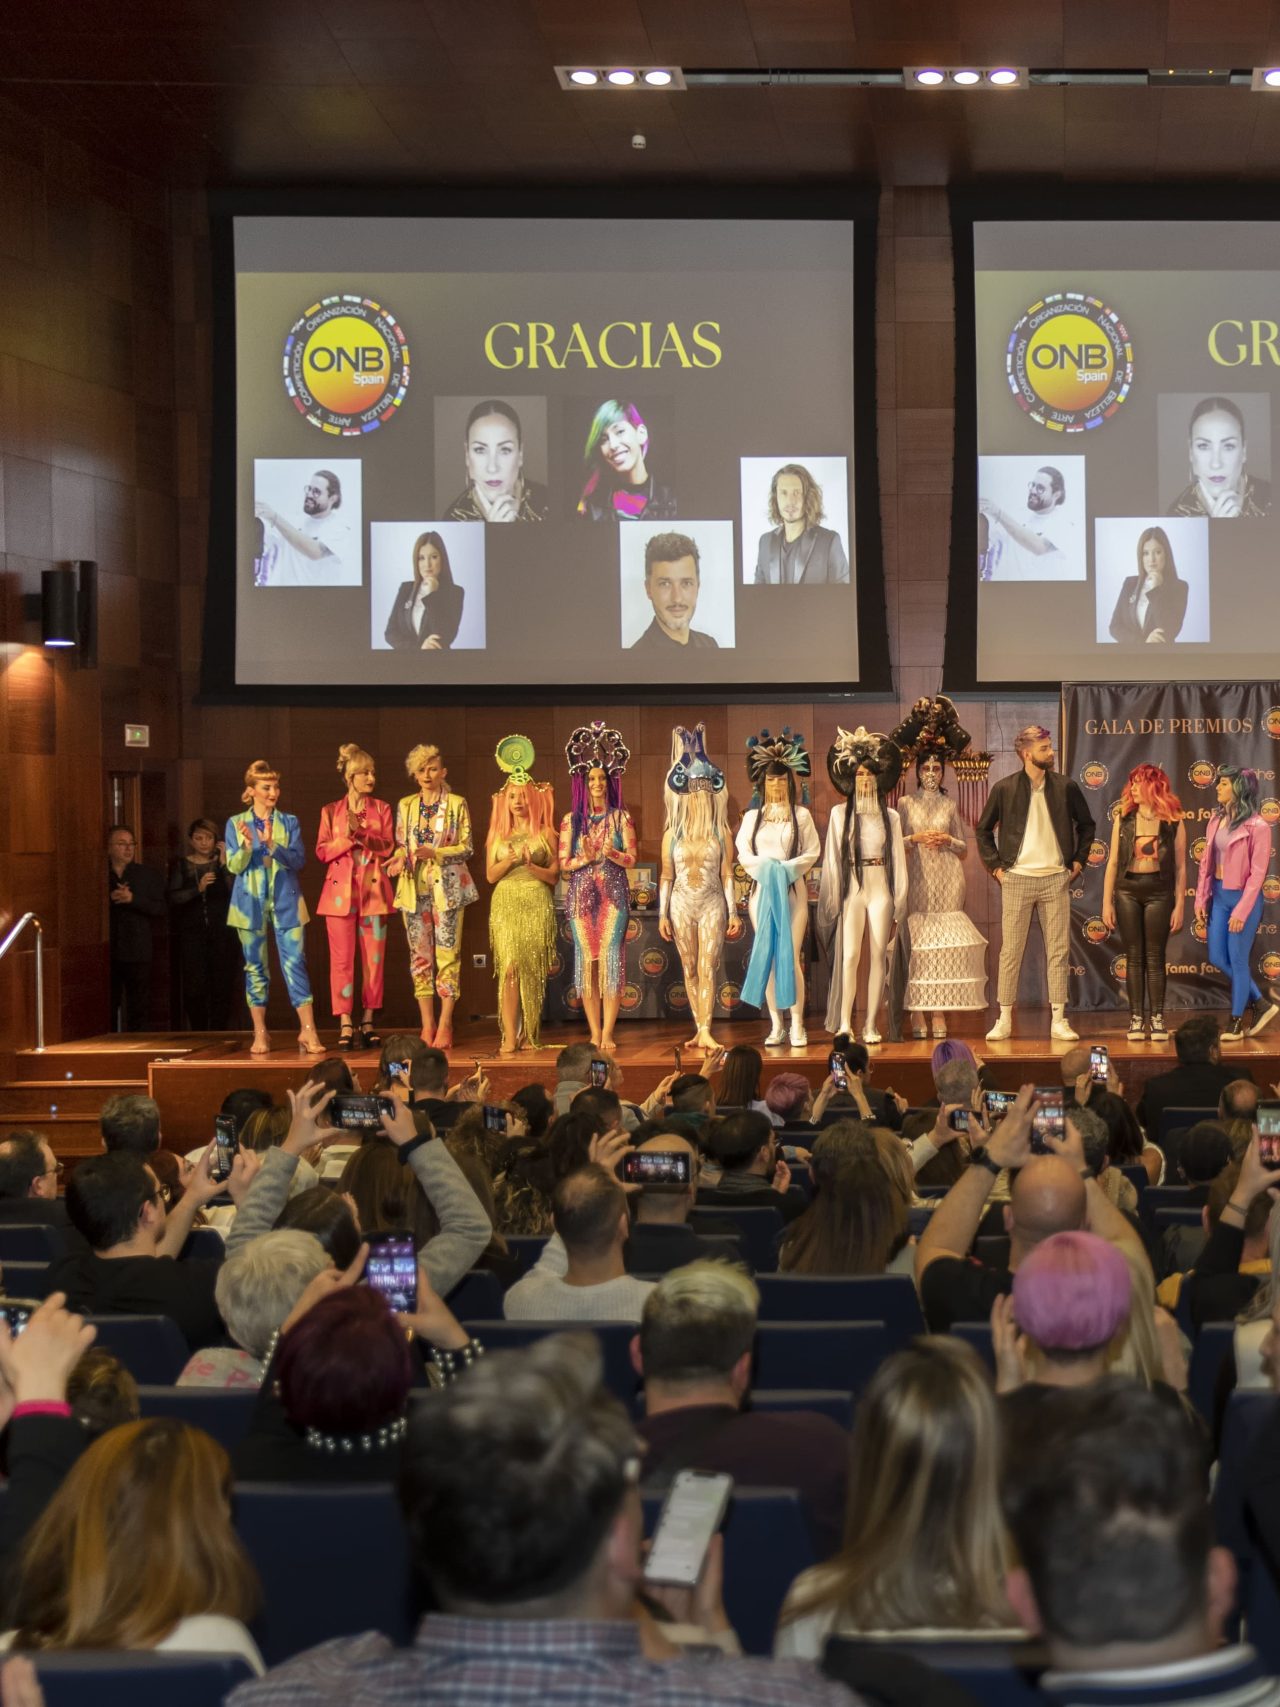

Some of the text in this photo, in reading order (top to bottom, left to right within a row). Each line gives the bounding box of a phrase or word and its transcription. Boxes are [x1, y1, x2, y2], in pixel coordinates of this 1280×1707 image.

[1029, 303, 1090, 329] ORGANIZACIÓN
[374, 317, 400, 361] NACIONAL
[484, 321, 722, 369] GRACIAS
[1097, 315, 1123, 359] NACIONAL
[309, 346, 384, 372] ONB
[1031, 344, 1108, 370] ONB
[353, 372, 385, 387] Spain
[391, 373, 400, 386] DE
[1076, 369, 1108, 384] Spain
[1115, 370, 1124, 384] DE
[361, 393, 394, 421] BELLEZA
[1084, 390, 1117, 419] BELLEZA
[328, 414, 351, 427] ARTE
[1051, 411, 1075, 423] ARTE
[1085, 717, 1253, 735] GALA DE PREMIOS
[1263, 884, 1280, 892] ONB
[1165, 962, 1197, 975] fama
